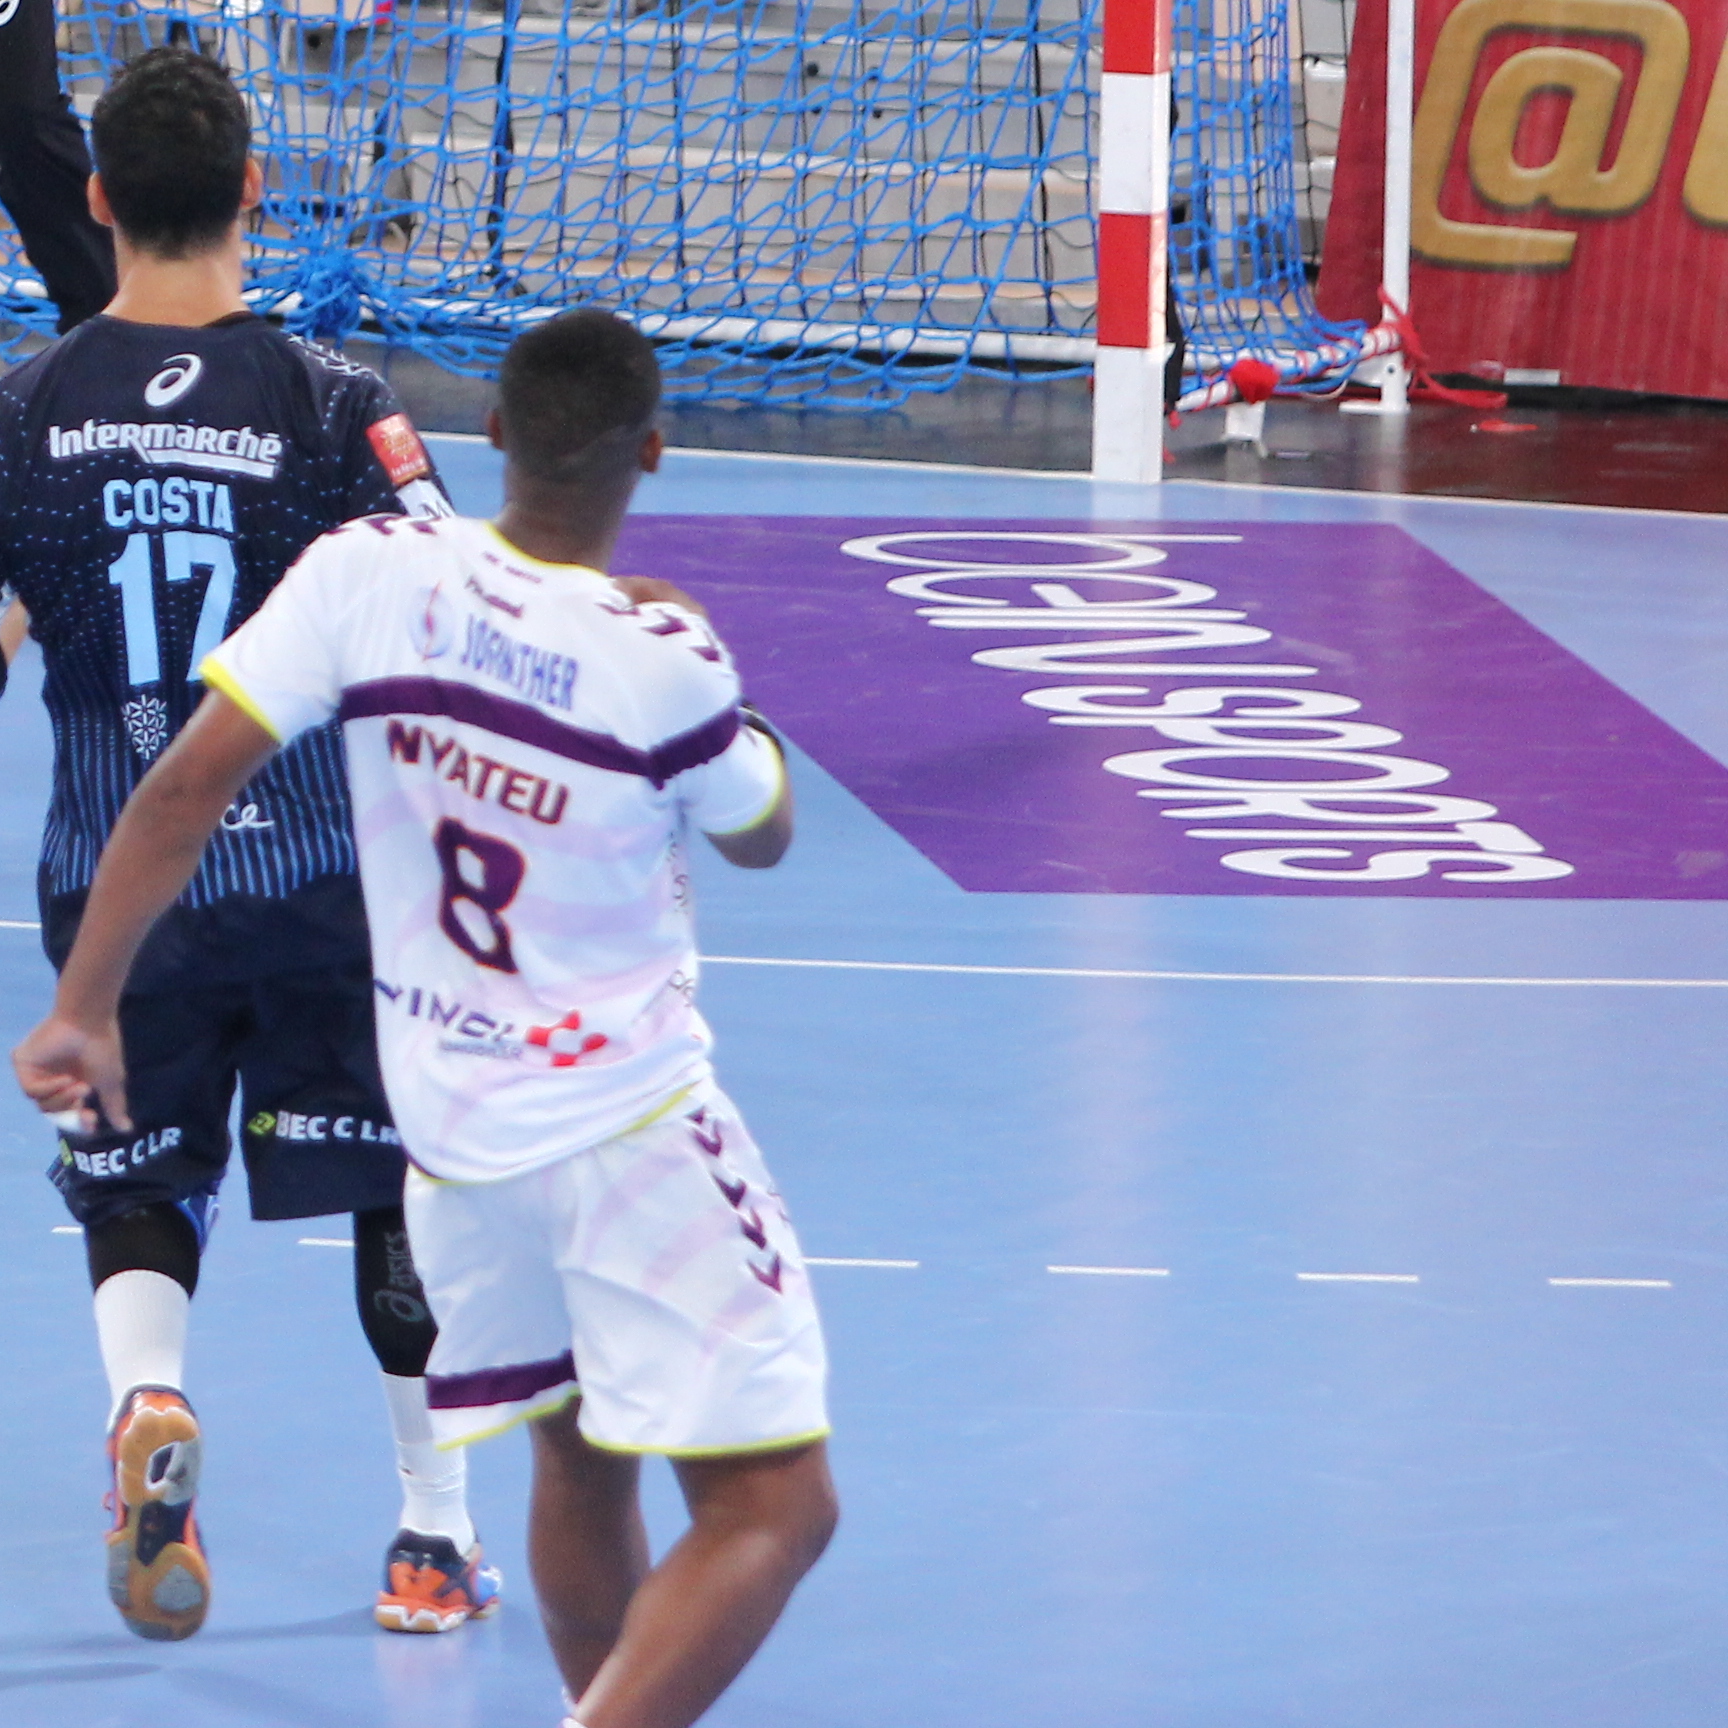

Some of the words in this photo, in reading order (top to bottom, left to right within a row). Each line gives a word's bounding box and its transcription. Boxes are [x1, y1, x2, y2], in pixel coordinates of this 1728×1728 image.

[102, 476, 235, 534] COSTA
[107, 529, 239, 686] 17
[387, 718, 570, 825] NYATEU
[433, 815, 527, 975] 8
